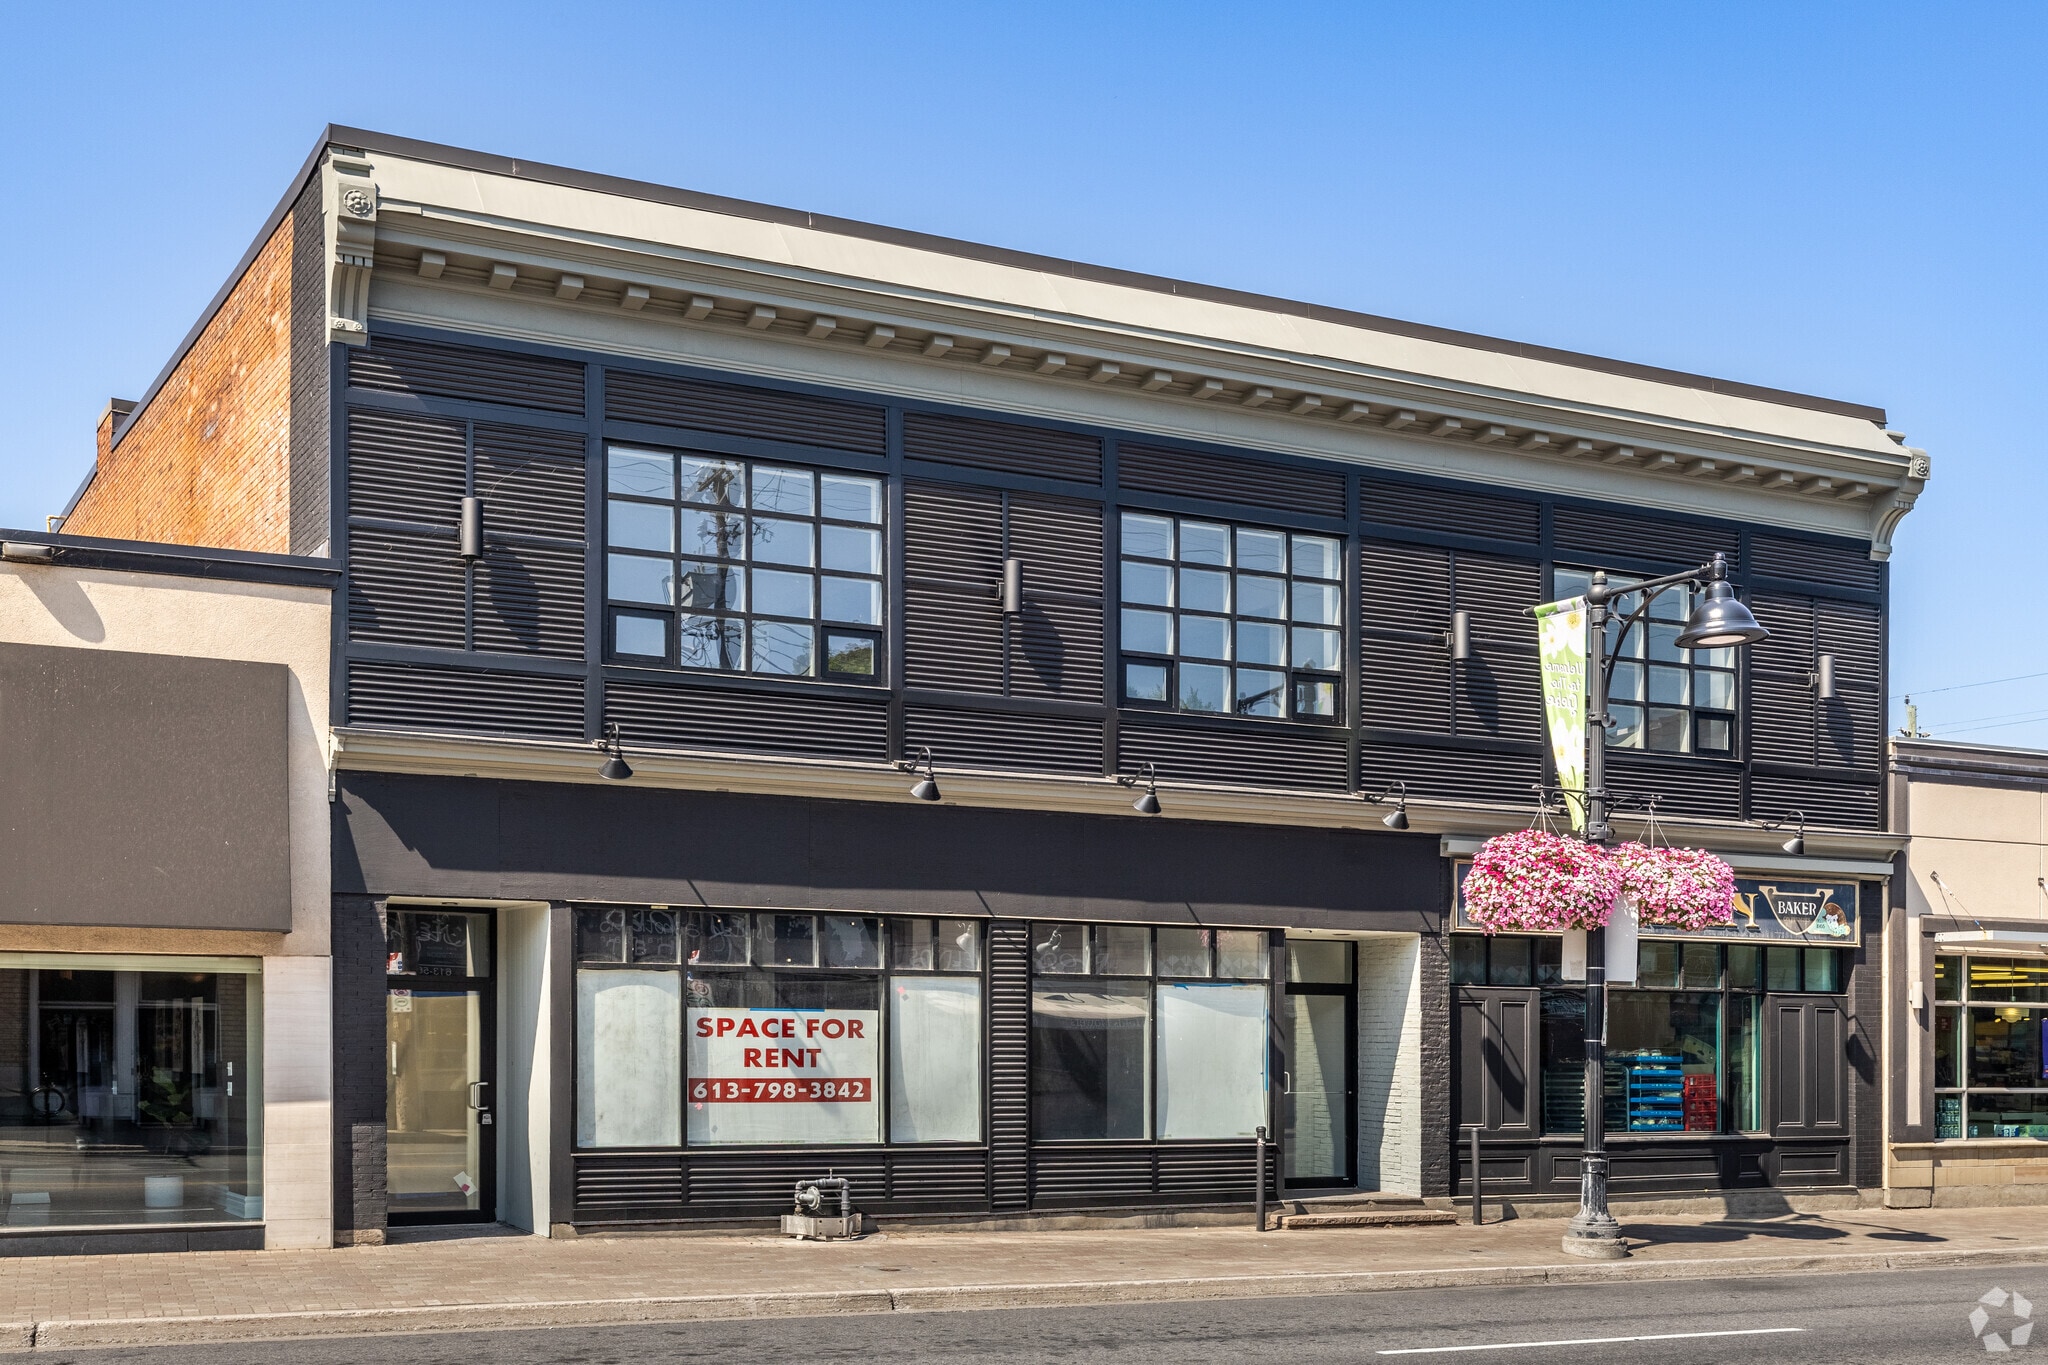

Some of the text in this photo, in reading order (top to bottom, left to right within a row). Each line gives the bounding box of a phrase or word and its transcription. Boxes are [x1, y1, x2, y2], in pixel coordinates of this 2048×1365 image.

[1777, 900, 1818, 916] BAKER
[696, 1017, 865, 1039] SPACE FOR
[743, 1048, 822, 1068] RENT
[693, 1081, 865, 1099] 613-798-3842
